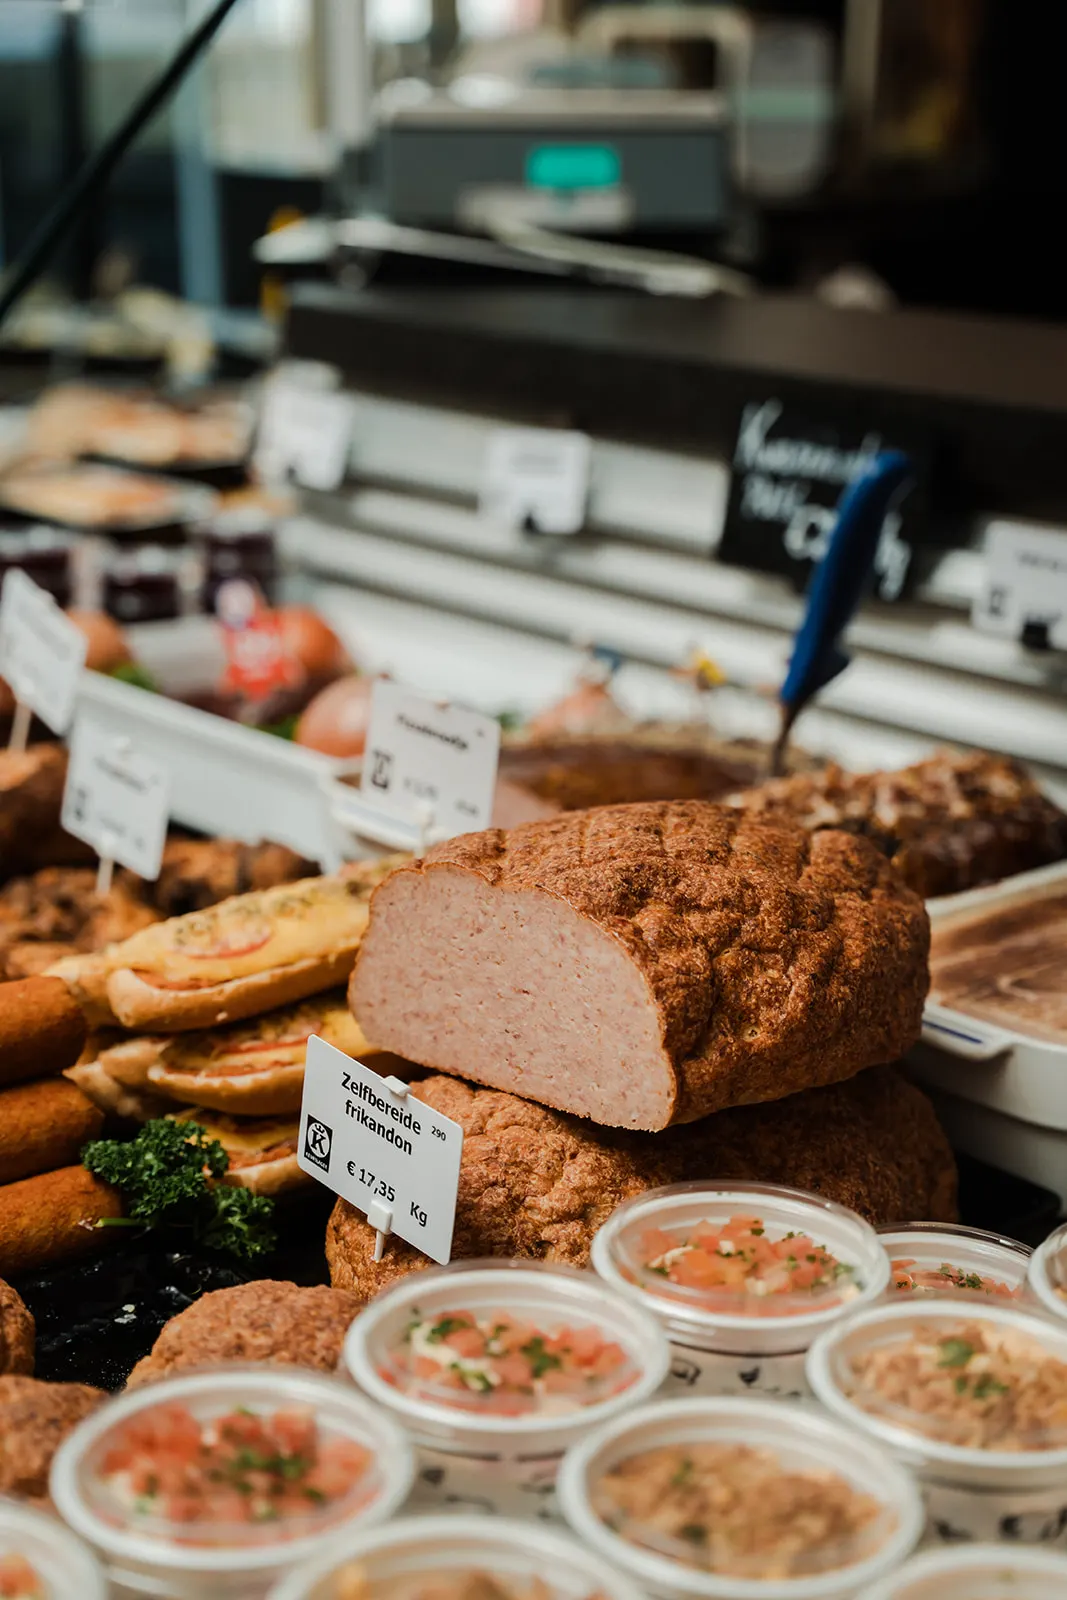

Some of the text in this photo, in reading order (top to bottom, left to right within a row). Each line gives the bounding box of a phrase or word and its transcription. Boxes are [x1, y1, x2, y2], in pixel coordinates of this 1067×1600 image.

[341, 1072, 421, 1135] Zelfbereide
[346, 1100, 412, 1155] frikandon
[431, 1125, 447, 1142] 290
[410, 1202, 428, 1227] Kg
